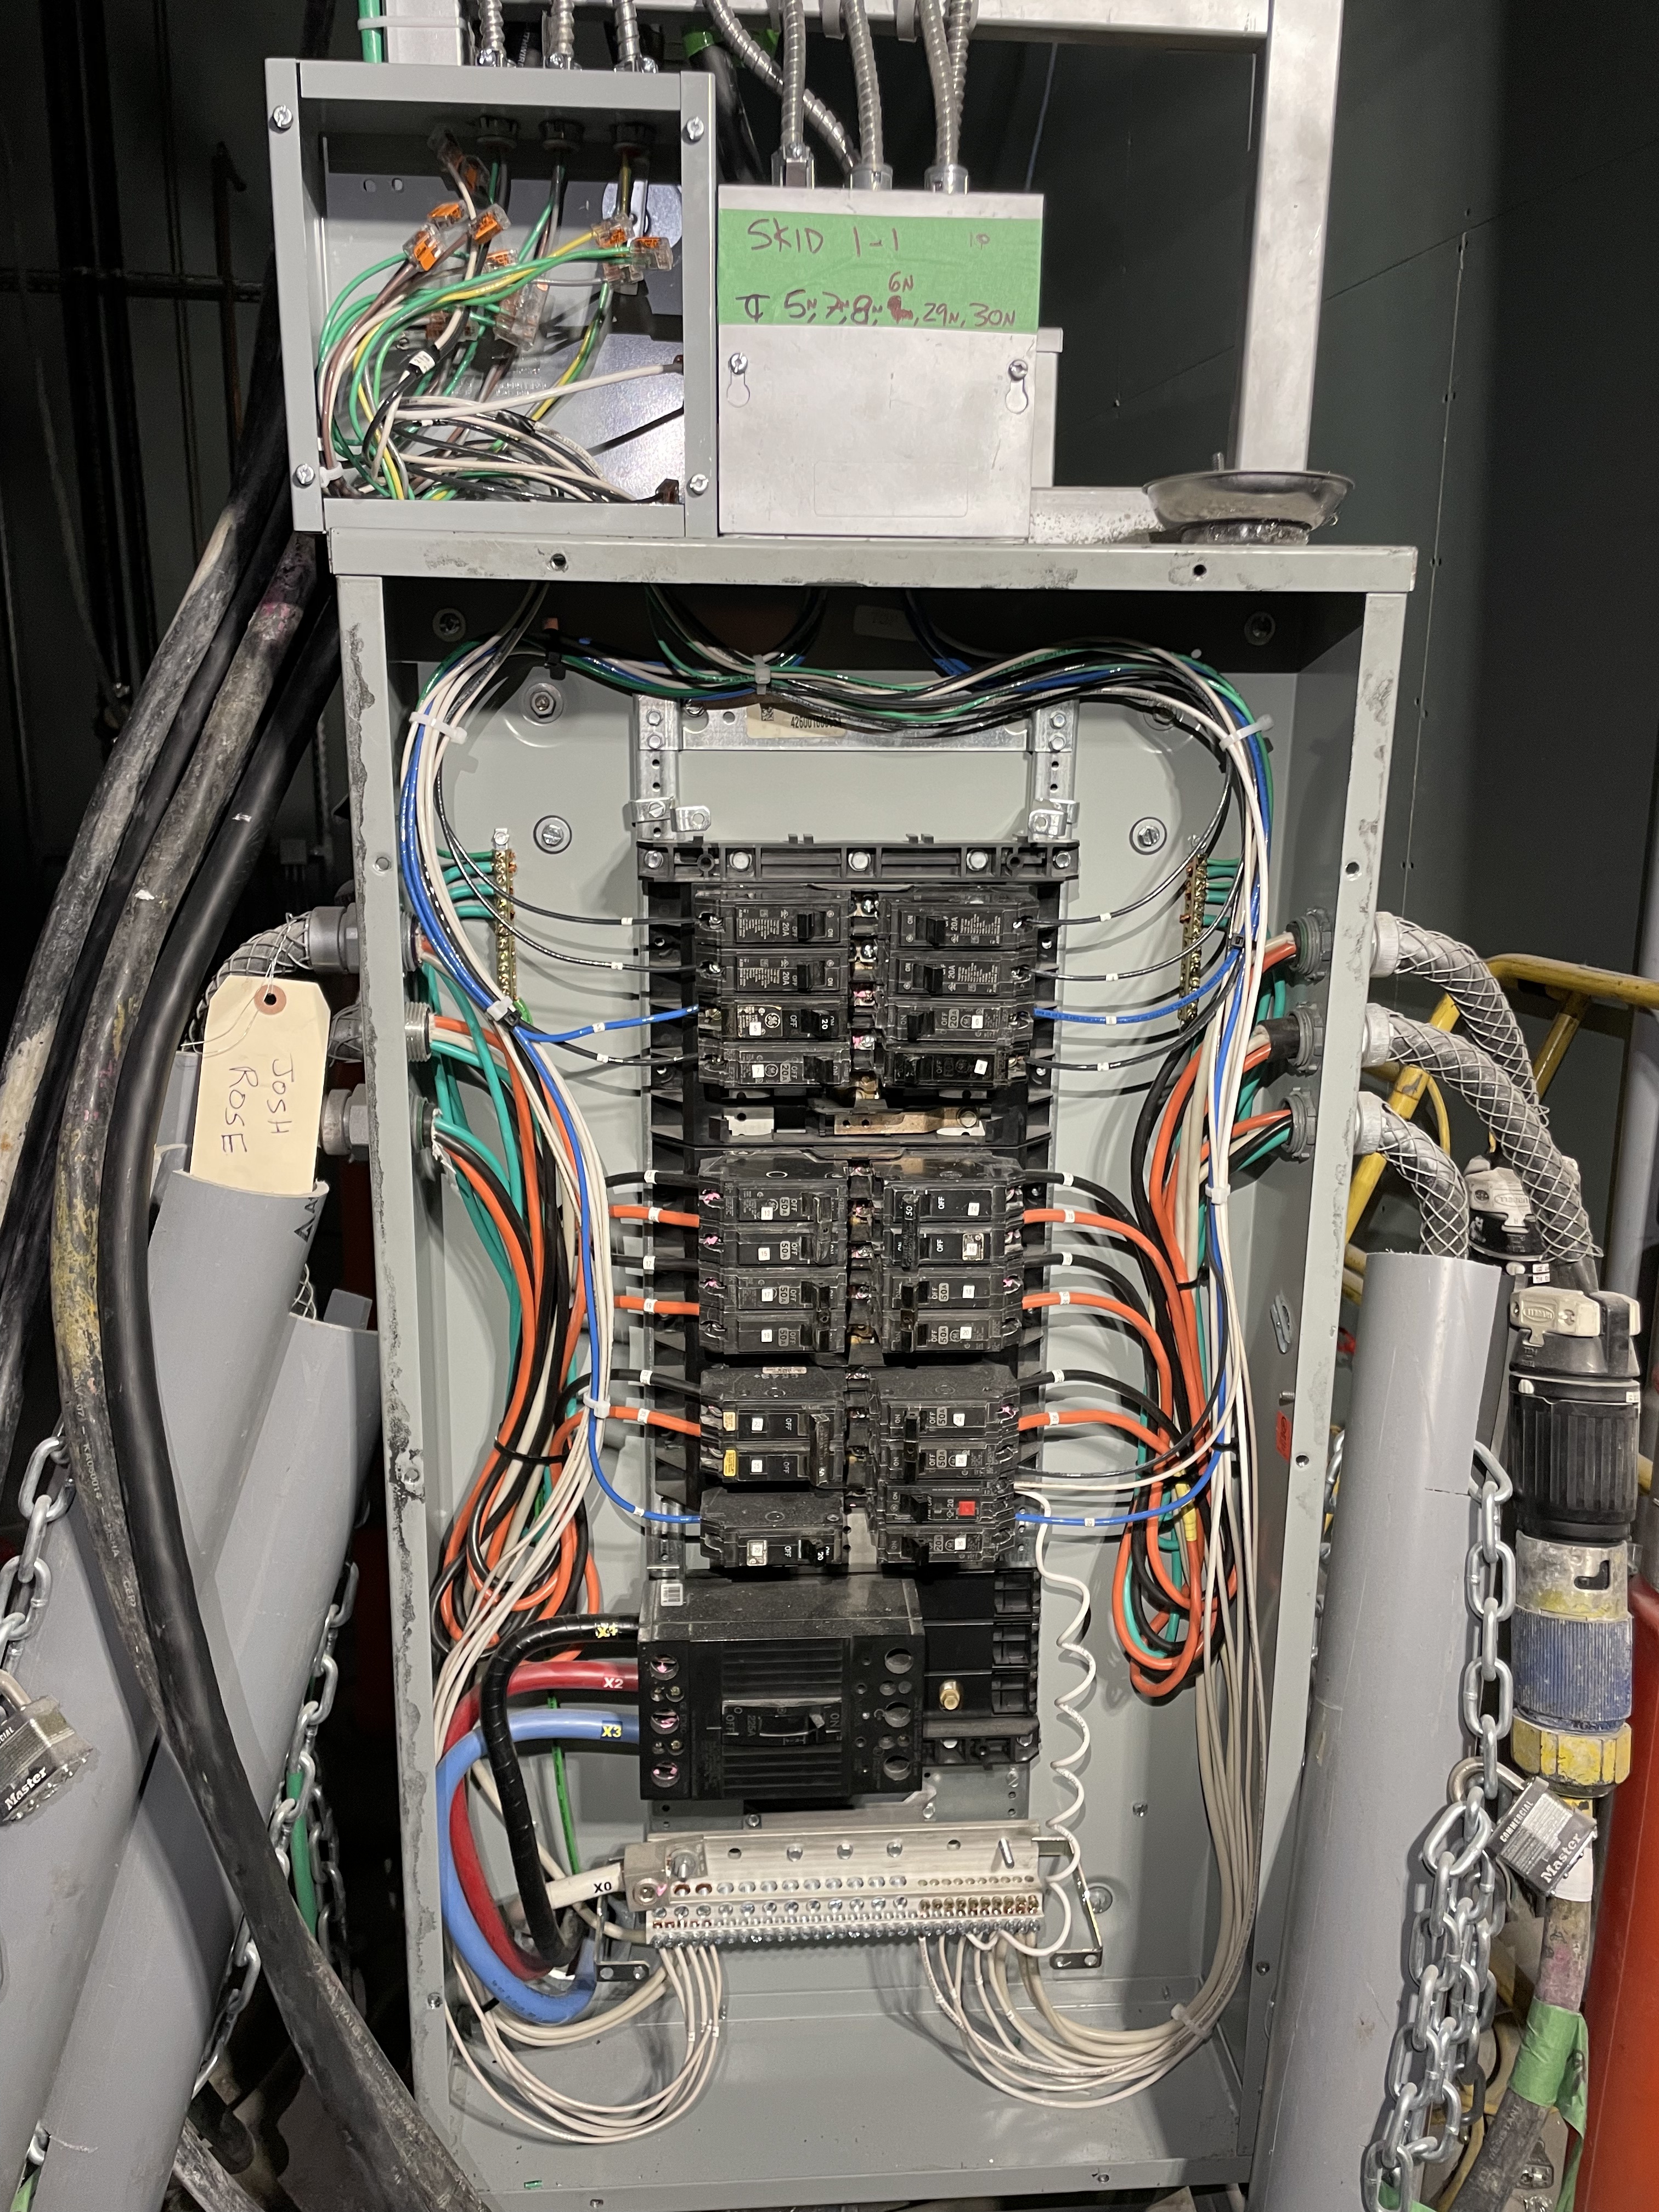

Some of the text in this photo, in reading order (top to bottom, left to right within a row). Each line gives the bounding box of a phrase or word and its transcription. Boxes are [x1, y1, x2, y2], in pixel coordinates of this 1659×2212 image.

[748, 217, 824, 254] SKID
[888, 270, 914, 293] 6N
[907, 916, 913, 924] ON
[782, 922, 790, 937] 20A
[827, 928, 833, 938] ON
[905, 963, 911, 972] ON
[782, 971, 791, 986] 20A
[827, 977, 833, 987] ON
[822, 1018, 828, 1030] 20
[900, 1014, 907, 1025] ON
[950, 1011, 958, 1027] 20A
[781, 1065, 789, 1081] 20A
[267, 1053, 295, 1134] JOSH
[221, 1066, 259, 1153] ROSE
[764, 1209, 771, 1217] 13
[906, 1206, 913, 1216] 50
[781, 1243, 789, 1259] 50A
[780, 1287, 788, 1304] 50A
[780, 1329, 788, 1346] 50A
[895, 1331, 901, 1341] ON
[940, 1328, 948, 1344] 50A
[894, 1414, 901, 1424] ON
[938, 1409, 946, 1425] 50A
[893, 1456, 900, 1466] ON
[938, 1451, 946, 1468] 50A
[892, 1491, 899, 1500] ON
[947, 1498, 955, 1508] 20
[890, 1539, 898, 1550] ON
[935, 1535, 943, 1551] 20A
[817, 1551, 824, 1561] 20
[603, 1677, 624, 1689] X2
[726, 1714, 735, 1733] OFF
[747, 1715, 757, 1737] 225A
[830, 1712, 840, 1728] ON
[601, 1725, 622, 1737] X3
[4, 1766, 47, 1811] Master
[1499, 1800, 1534, 1843] COMMERCIAL
[1541, 1833, 1582, 1884] Master
[594, 1882, 612, 1893] X0
